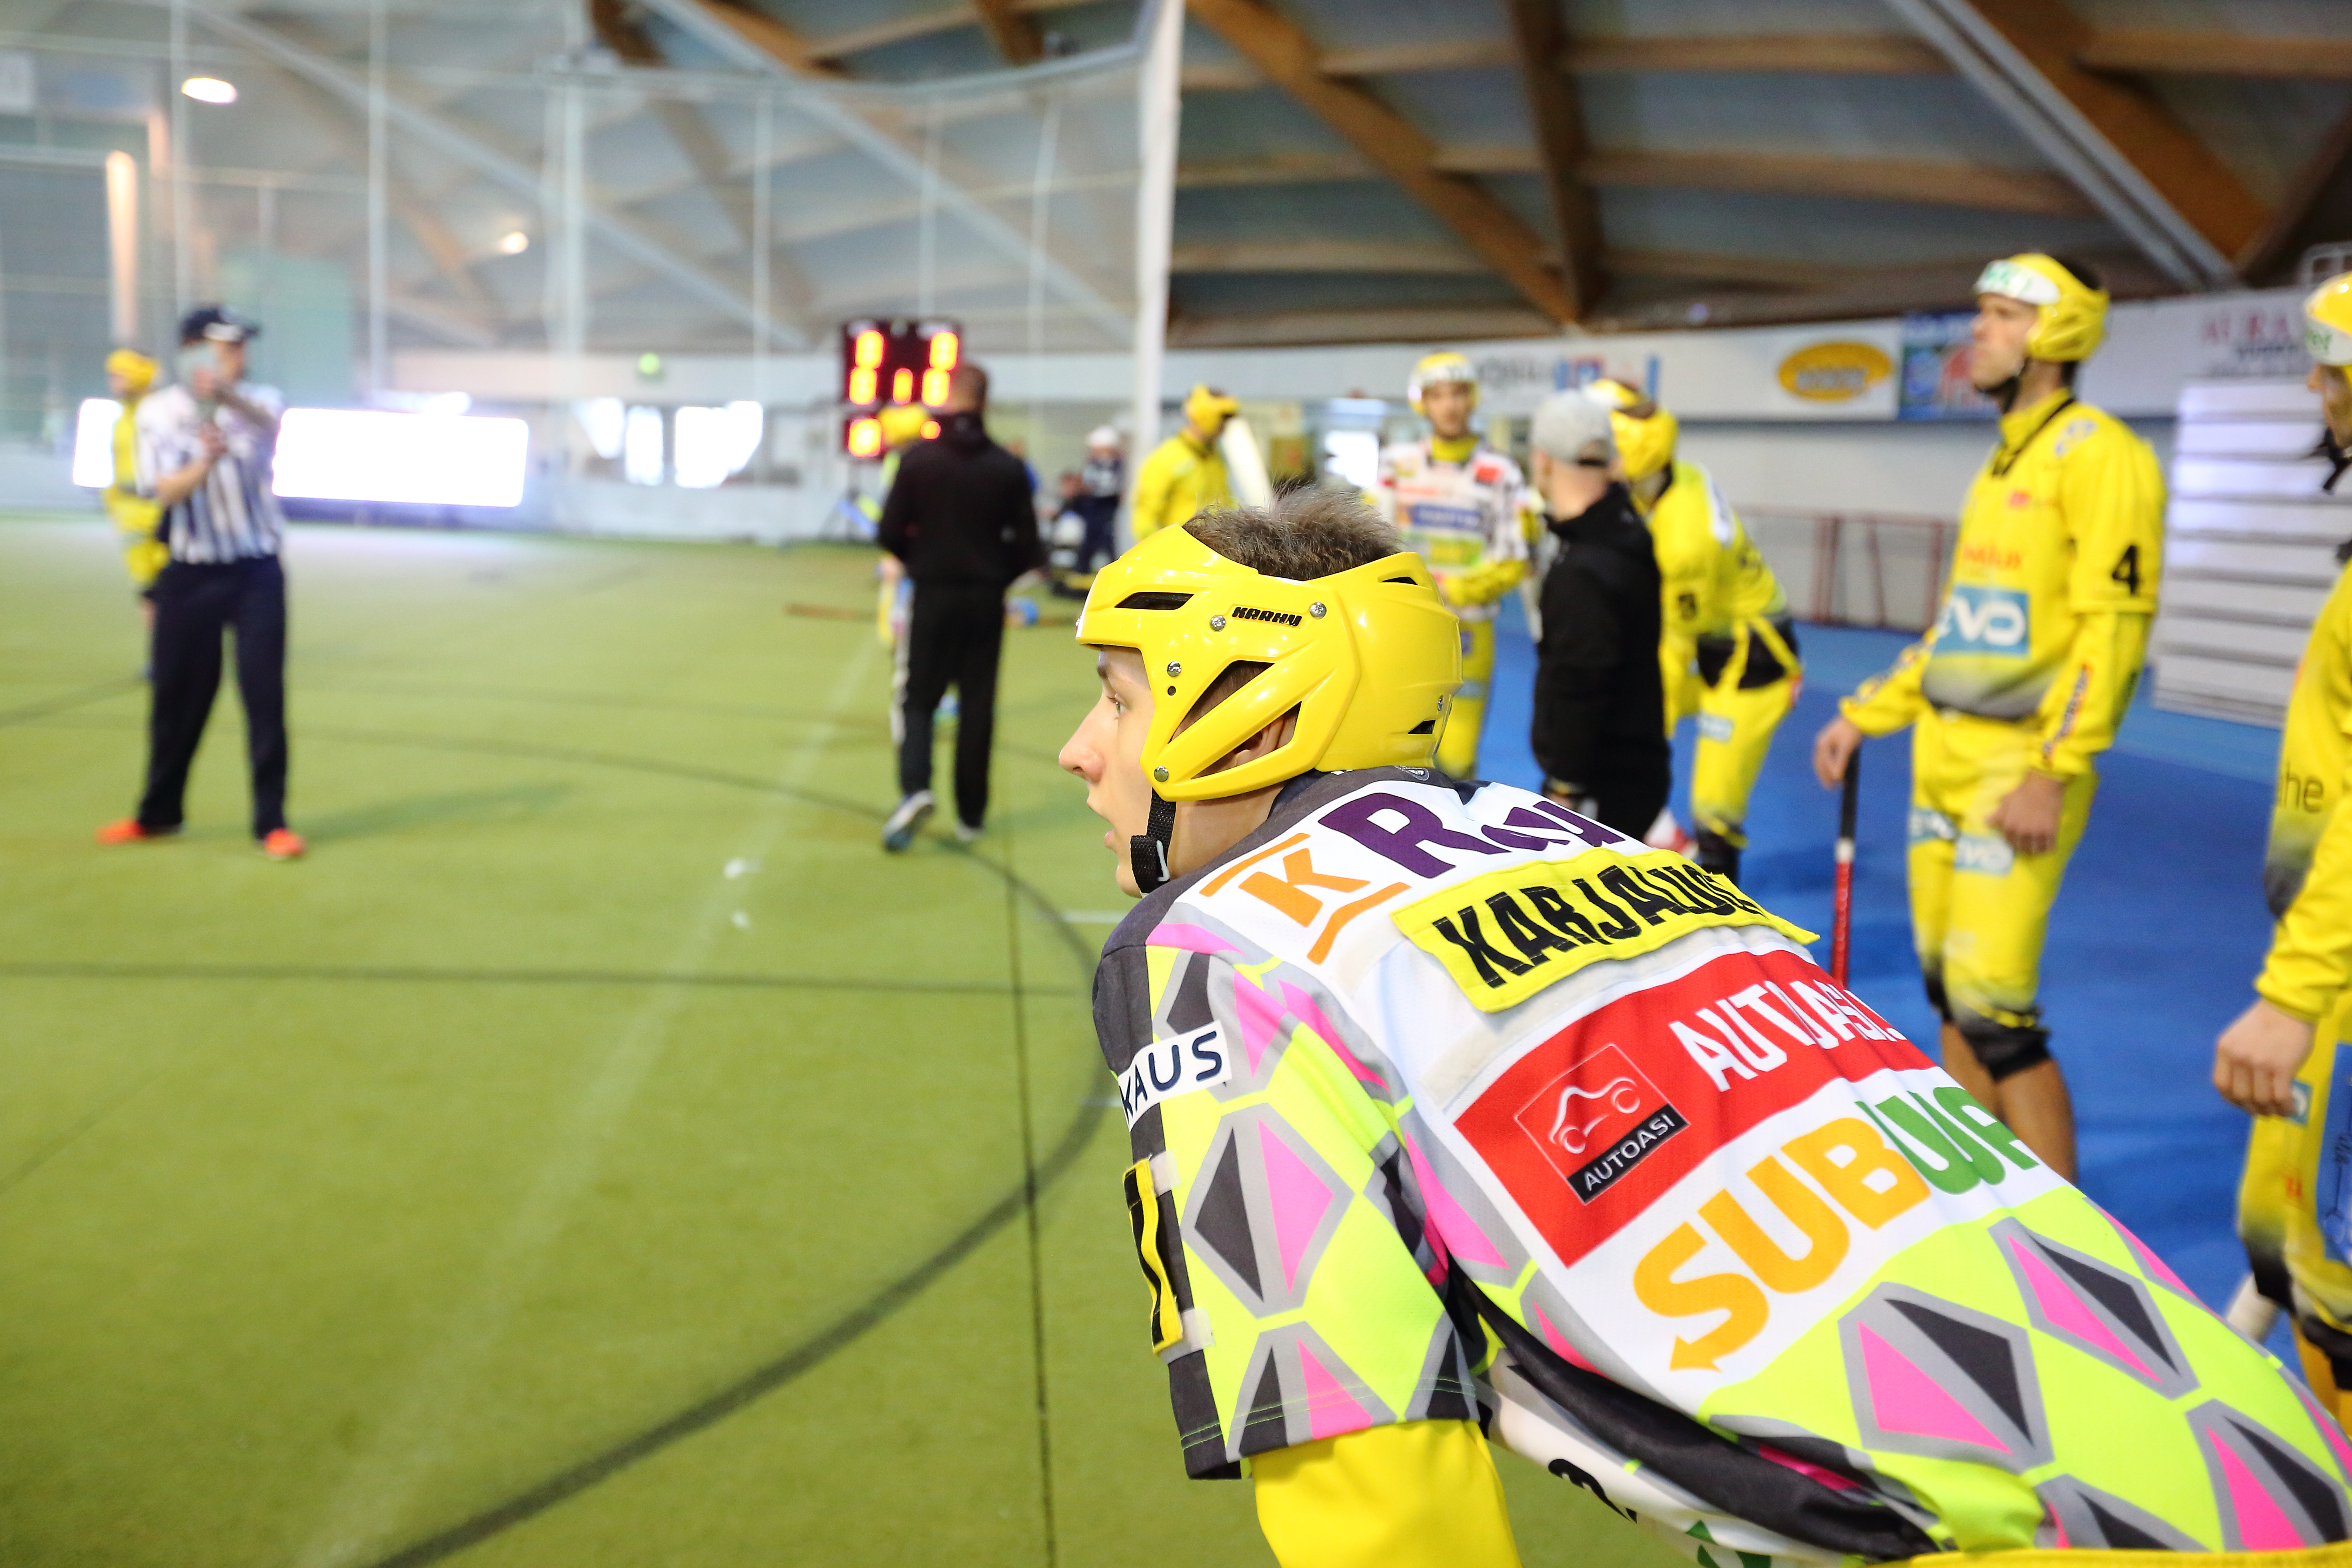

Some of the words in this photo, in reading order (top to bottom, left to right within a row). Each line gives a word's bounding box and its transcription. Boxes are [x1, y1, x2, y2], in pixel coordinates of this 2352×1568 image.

[2111, 544, 2141, 595] 4
[1232, 606, 1303, 627] KARHU
[2278, 762, 2324, 813] he
[1584, 1113, 1675, 1192] AUTOASI
